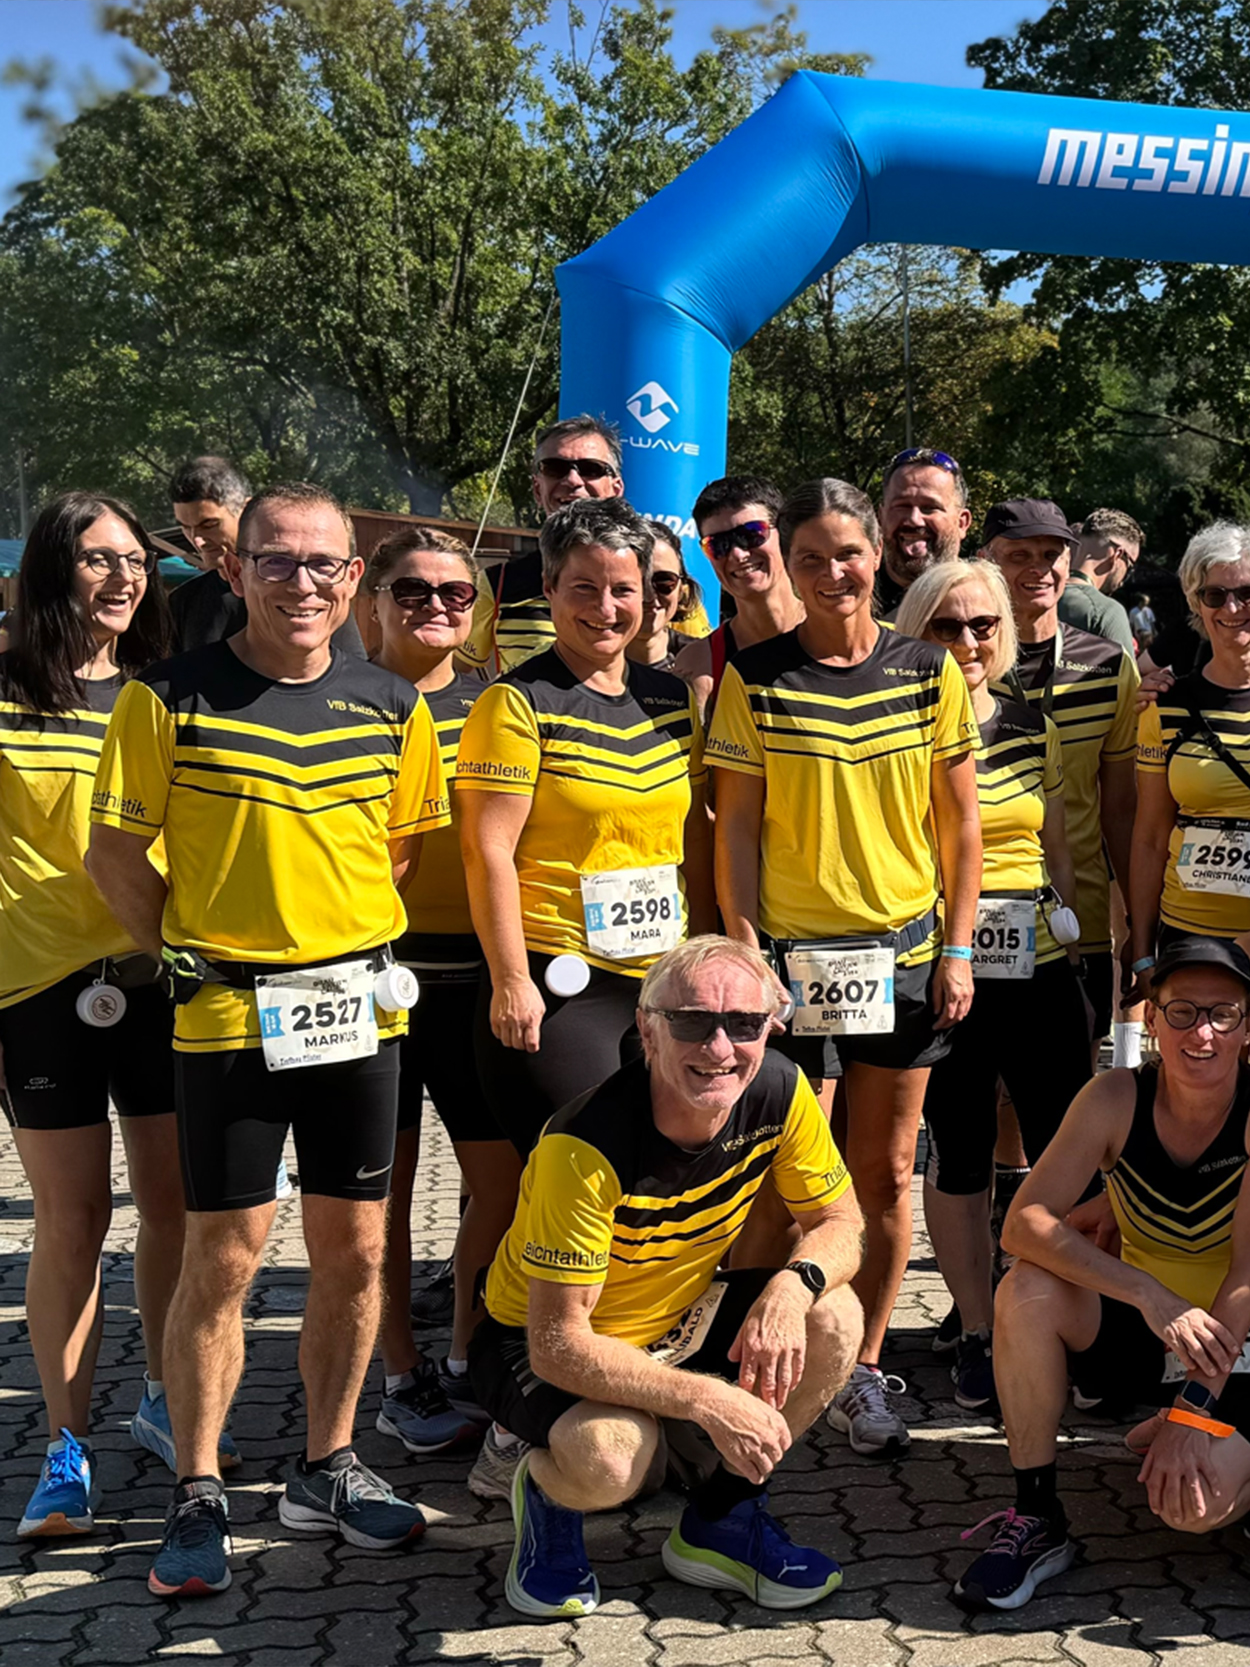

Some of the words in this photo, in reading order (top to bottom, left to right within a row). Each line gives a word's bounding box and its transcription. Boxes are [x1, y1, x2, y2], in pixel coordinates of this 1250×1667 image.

[620, 436, 700, 457] -WAVE
[610, 896, 671, 927] 2598
[630, 928, 662, 941] MARA
[972, 927, 1020, 950] 015
[970, 954, 1019, 965] ARGRET
[808, 980, 879, 1005] 2607
[291, 996, 362, 1032] 2527
[821, 1009, 868, 1021] BRITTA
[304, 1030, 359, 1049] MARKUS
